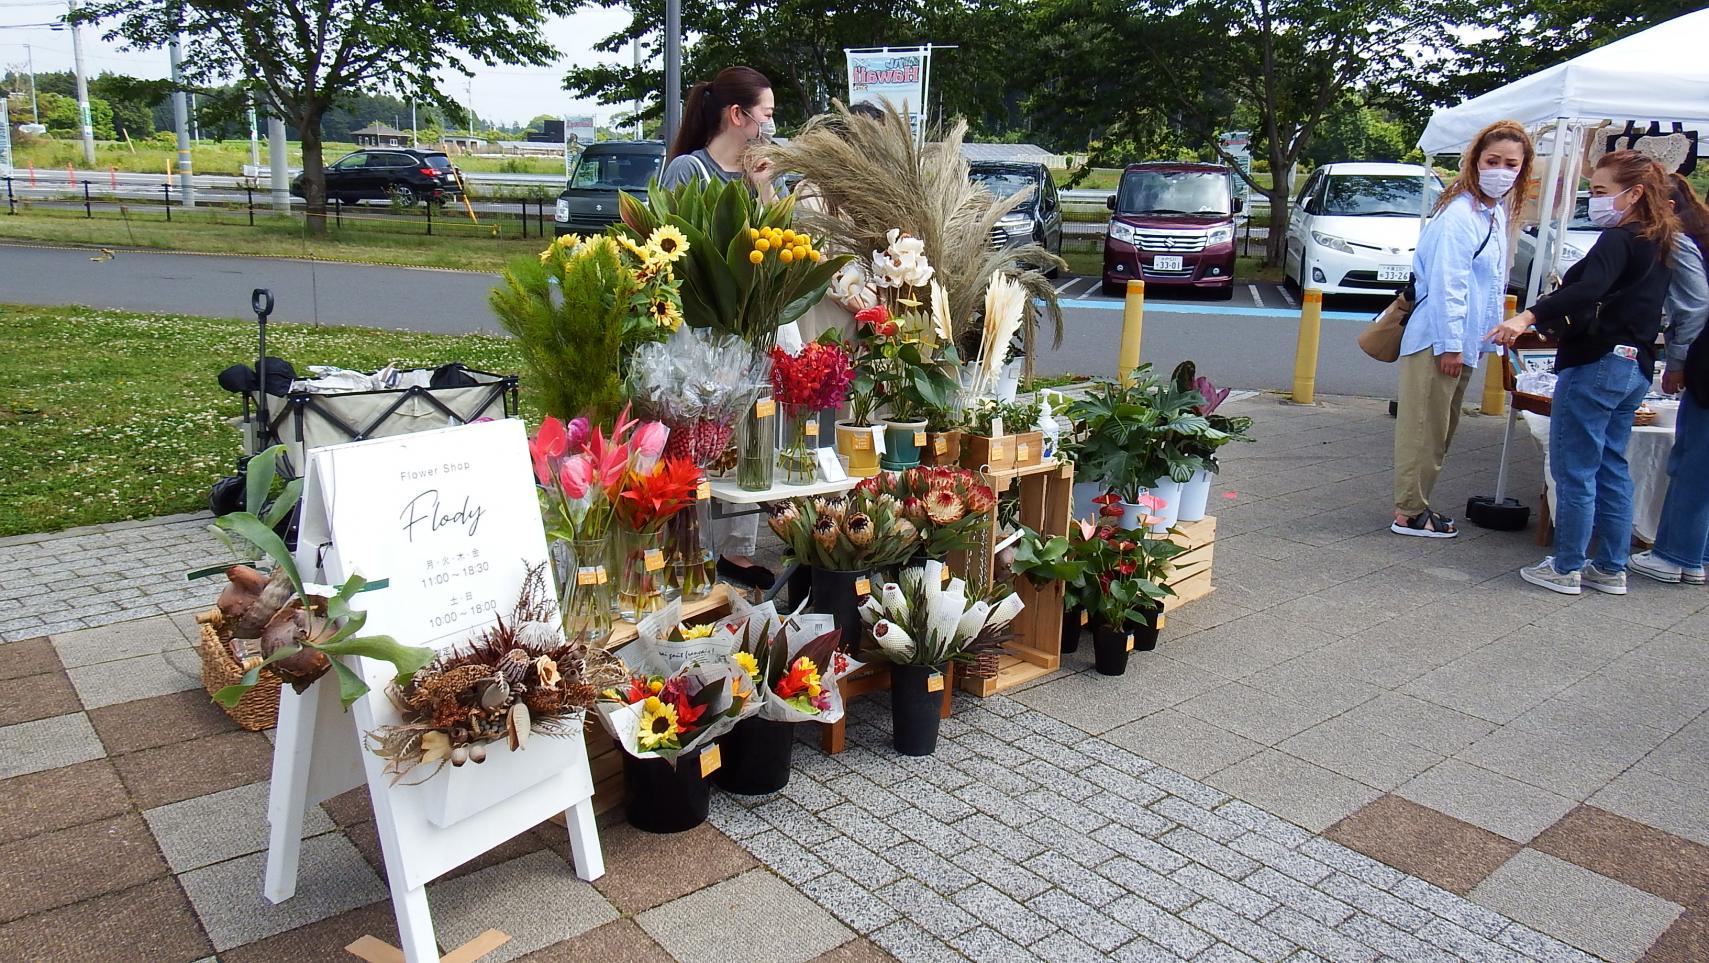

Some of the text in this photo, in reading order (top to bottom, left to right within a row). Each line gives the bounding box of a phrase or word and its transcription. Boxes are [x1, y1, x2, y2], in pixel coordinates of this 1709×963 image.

[1160, 261, 1180, 270] 33-01
[1384, 271, 1408, 280] 33-26
[400, 461, 470, 481] Flower Shop
[399, 489, 486, 543] Flody
